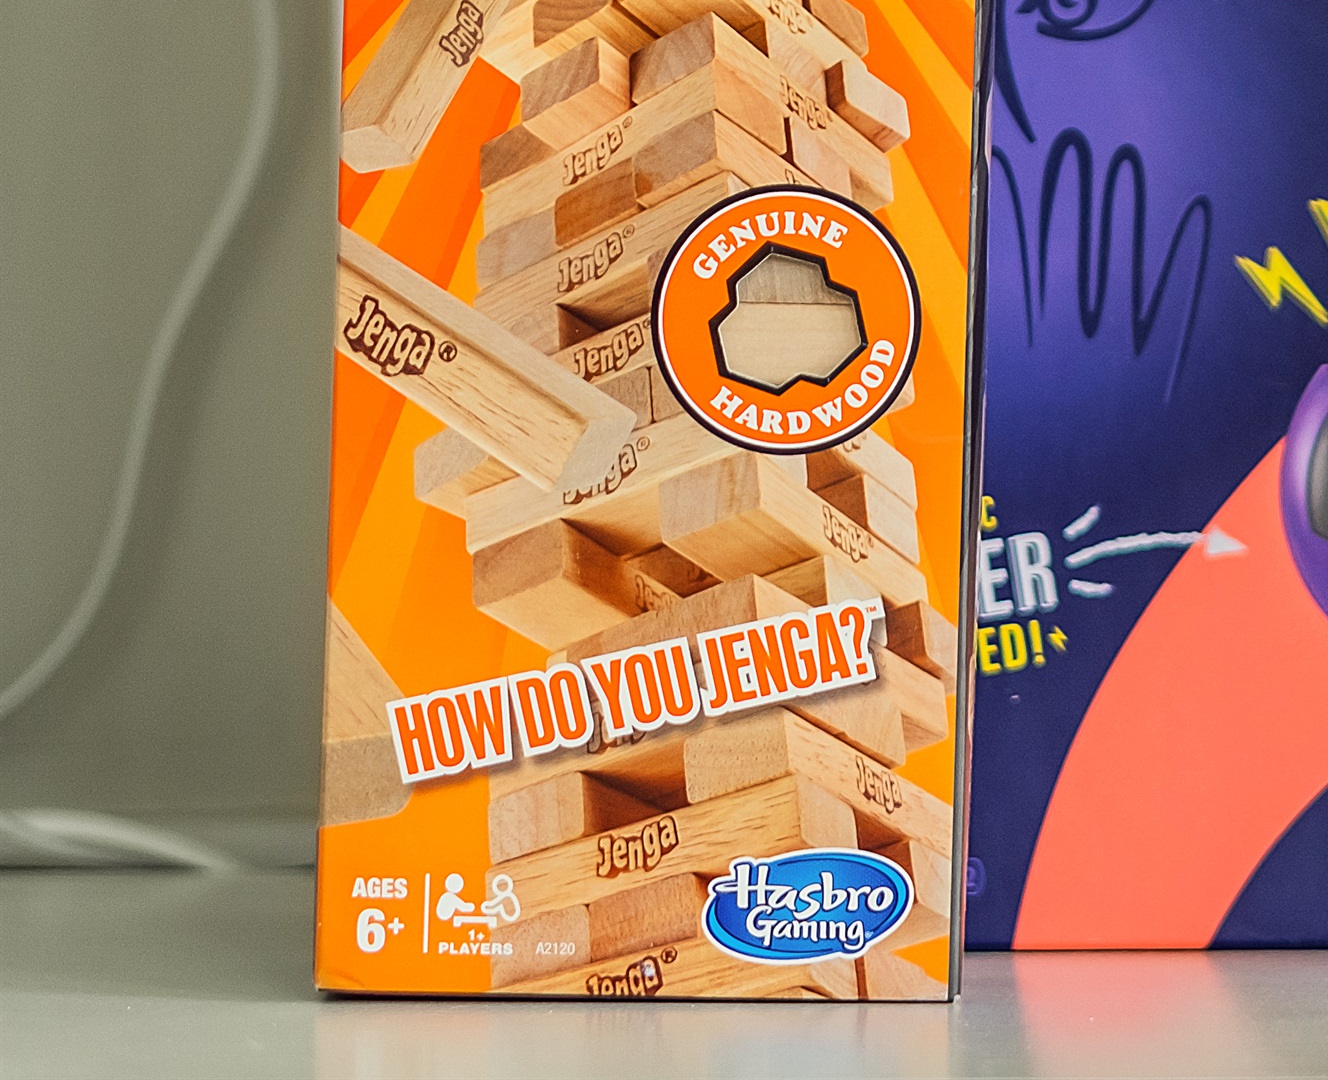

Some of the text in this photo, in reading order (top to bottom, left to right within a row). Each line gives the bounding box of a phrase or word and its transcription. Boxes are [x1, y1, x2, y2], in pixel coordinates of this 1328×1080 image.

[439, 0, 484, 67] Jenga
[780, 74, 828, 131] Jenga
[562, 124, 624, 186] Jenga
[558, 232, 624, 293] Jenga
[693, 211, 848, 279] GENUINE
[343, 294, 435, 377] Jenga
[574, 323, 645, 383] Jenga
[710, 340, 895, 434] HARDWOOD
[823, 505, 869, 563] Jenga
[394, 686, 505, 776] HOW
[515, 671, 589, 749] DO
[590, 646, 698, 730] YOU
[702, 606, 869, 709] JENGA?
[856, 756, 903, 815] Jenga
[597, 815, 679, 879] Jenga
[352, 877, 408, 899] AGES
[714, 863, 895, 920] Hasbro
[356, 908, 405, 953] 6+
[438, 942, 514, 955] PLAYERS
[468, 929, 485, 942] 1+
[535, 942, 576, 955] A2120
[746, 904, 865, 950] Gaming
